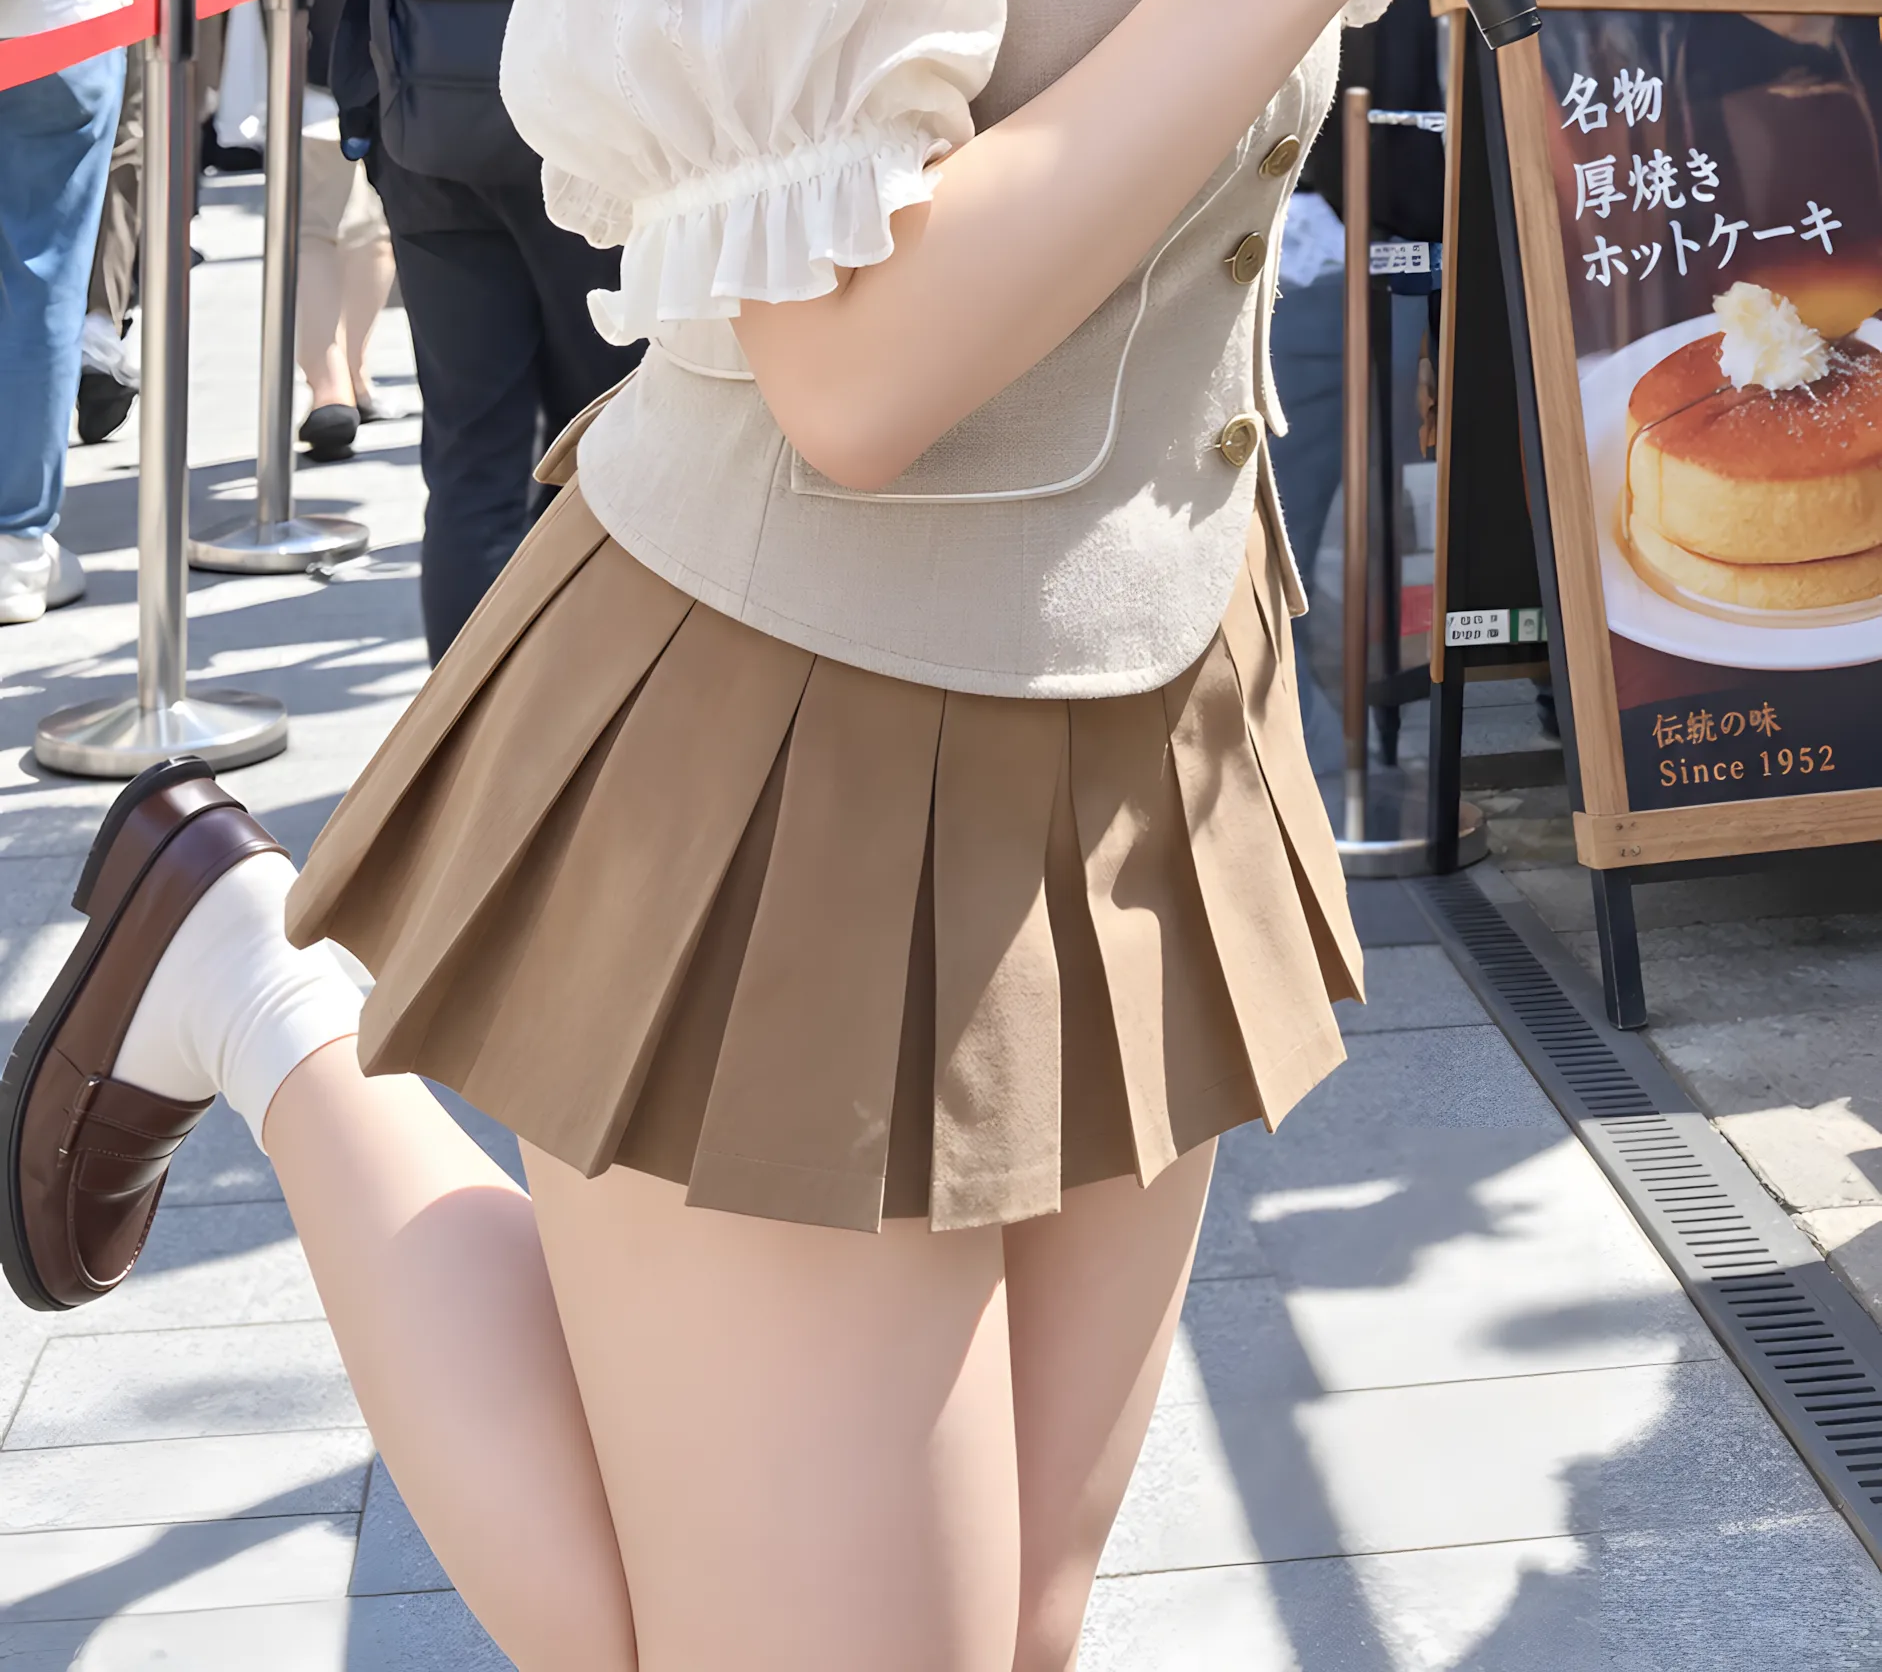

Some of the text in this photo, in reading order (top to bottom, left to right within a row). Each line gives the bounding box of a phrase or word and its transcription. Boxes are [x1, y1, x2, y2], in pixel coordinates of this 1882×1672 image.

[1560, 67, 1664, 135] 名物
[1573, 148, 1721, 221] 厚焼き
[1582, 200, 1843, 287] ホットケーキ
[1652, 701, 1783, 749] 伝統の味
[1659, 744, 1836, 787] Since 1952
